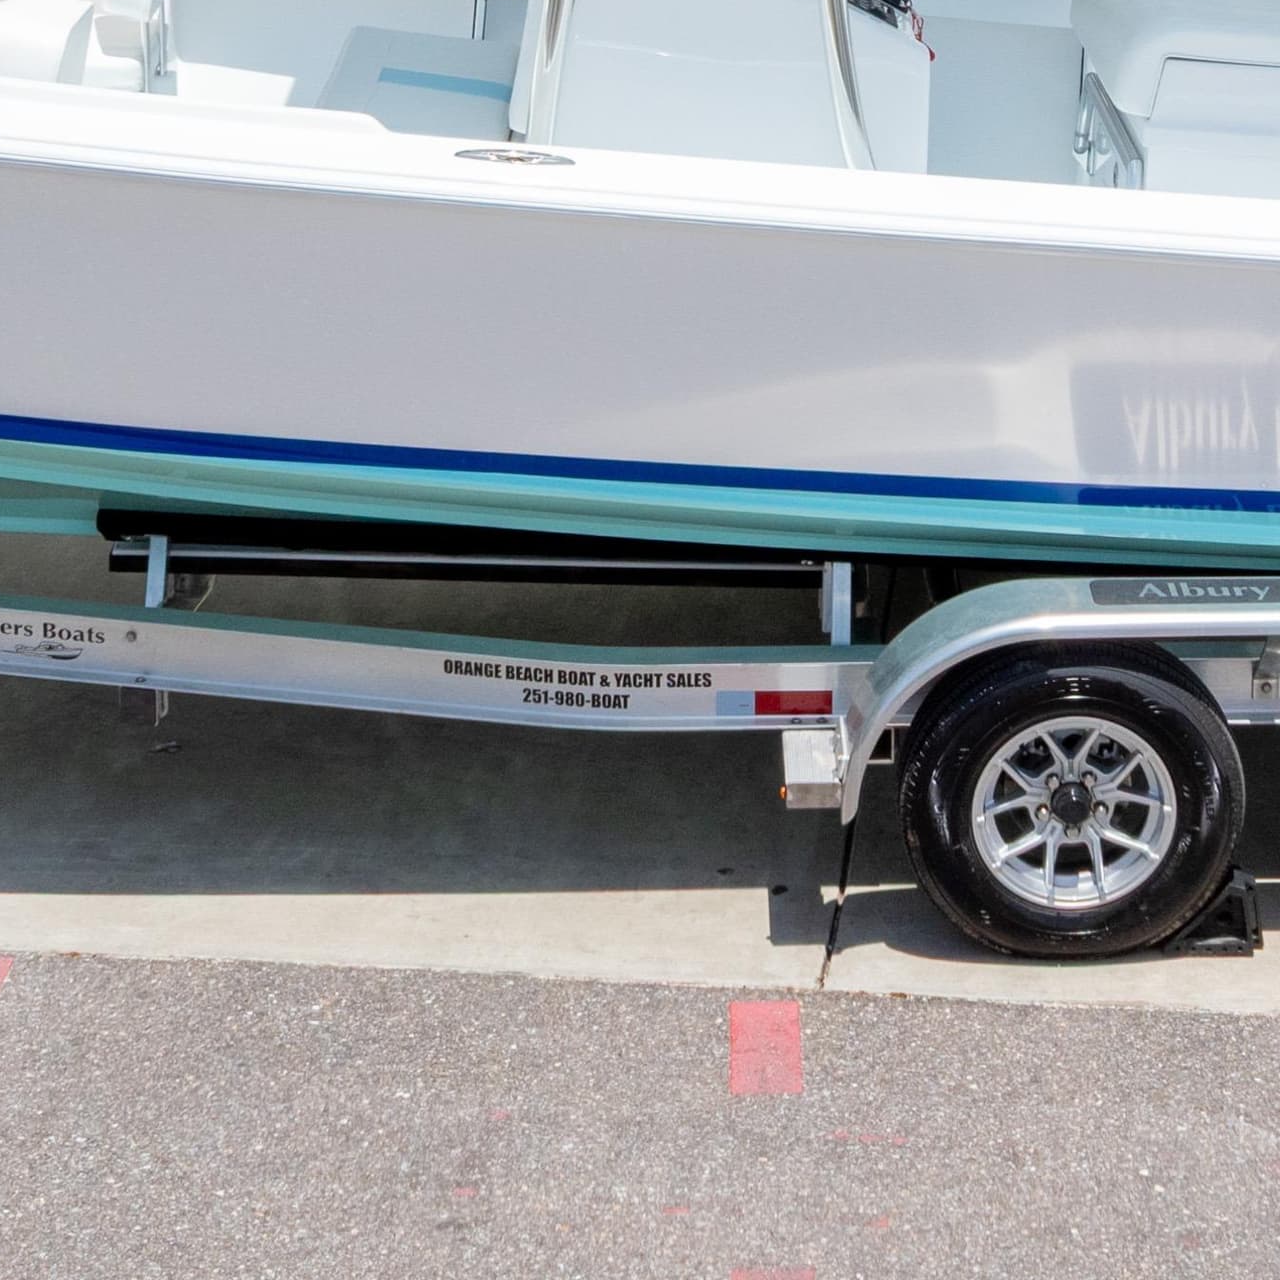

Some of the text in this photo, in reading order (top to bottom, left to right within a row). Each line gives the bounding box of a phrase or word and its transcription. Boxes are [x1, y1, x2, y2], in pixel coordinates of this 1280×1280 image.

[1139, 581, 1270, 601] Albury
[42, 622, 105, 644] Boats
[443, 659, 712, 688] ORANGE BEACH BOAT & YACHT SALES
[522, 688, 630, 710] 251-980-BOAT
